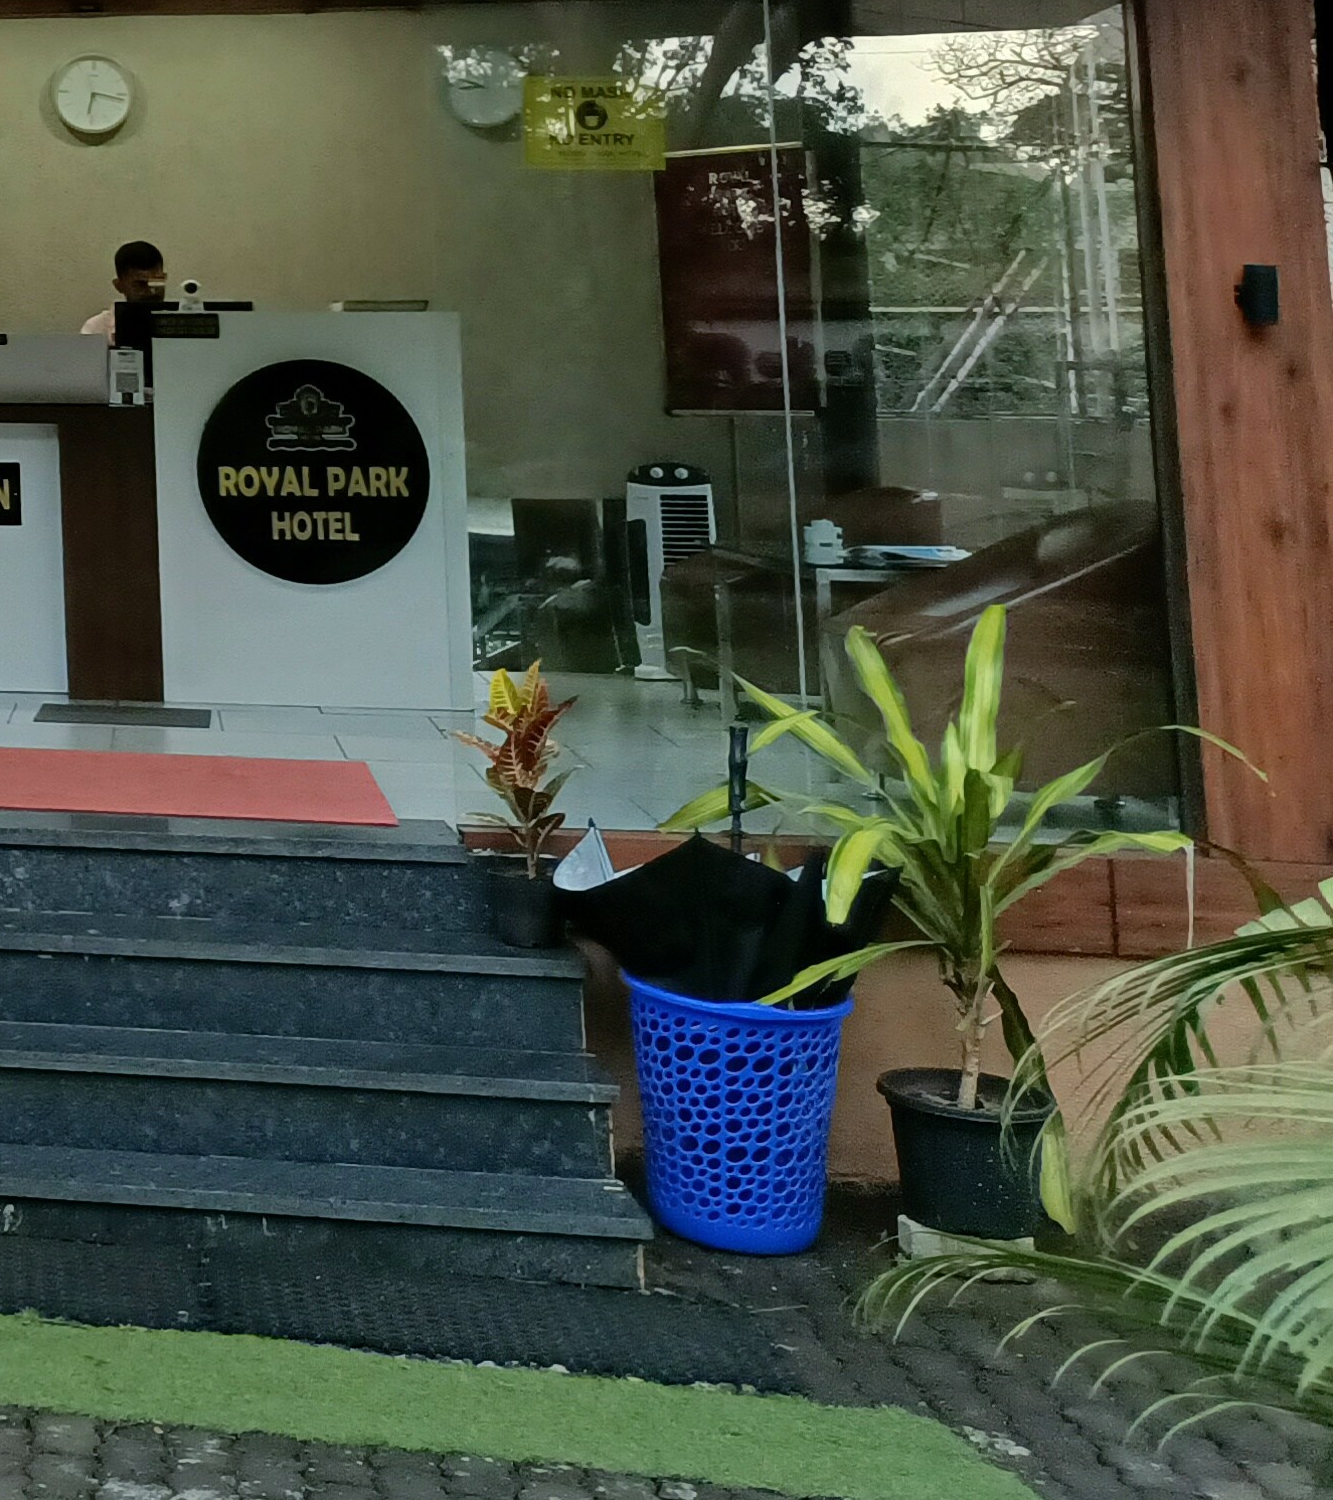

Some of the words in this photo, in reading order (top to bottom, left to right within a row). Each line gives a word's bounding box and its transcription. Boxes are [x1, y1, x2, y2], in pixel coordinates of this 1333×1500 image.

[550, 86, 576, 99] NO
[579, 133, 635, 146] ENTRY
[217, 465, 319, 497] ROYAL
[326, 466, 410, 498] PARK
[271, 511, 361, 541] HOTEL
